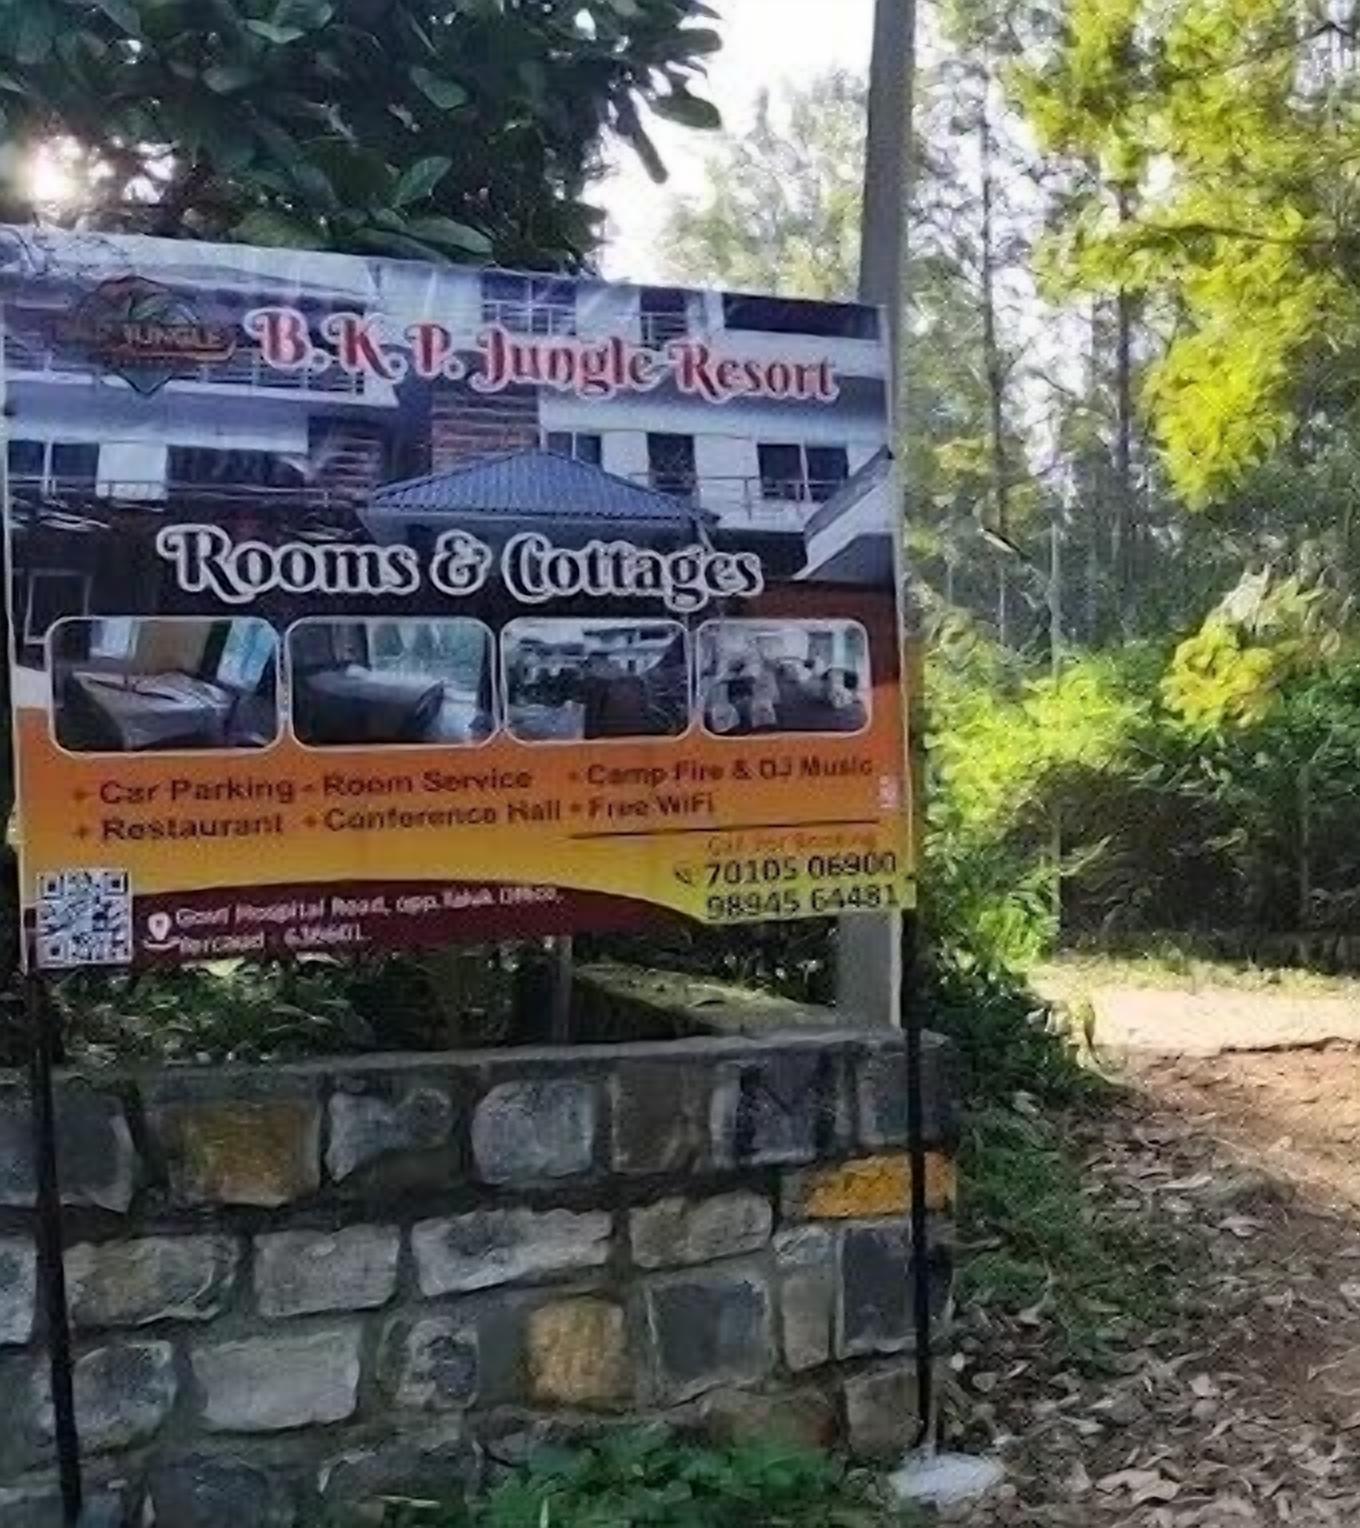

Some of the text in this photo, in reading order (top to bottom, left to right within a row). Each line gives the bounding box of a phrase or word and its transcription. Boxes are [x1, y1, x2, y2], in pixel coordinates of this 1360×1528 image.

[469, 322, 663, 400] Jungle
[667, 336, 840, 405] Resort
[157, 523, 764, 612] Rooms & Cottages
[323, 767, 533, 797] Room Service
[587, 763, 668, 788] Camp
[674, 759, 724, 781] Fire
[730, 759, 753, 780] &
[800, 756, 874, 778] Music
[100, 776, 295, 804] Car Parking
[587, 791, 714, 818] Free WiFi
[101, 813, 283, 841] Restaurant
[323, 799, 561, 832] Conference Hall
[705, 851, 897, 888] 70105 06900
[706, 884, 899, 920] 98945 64481
